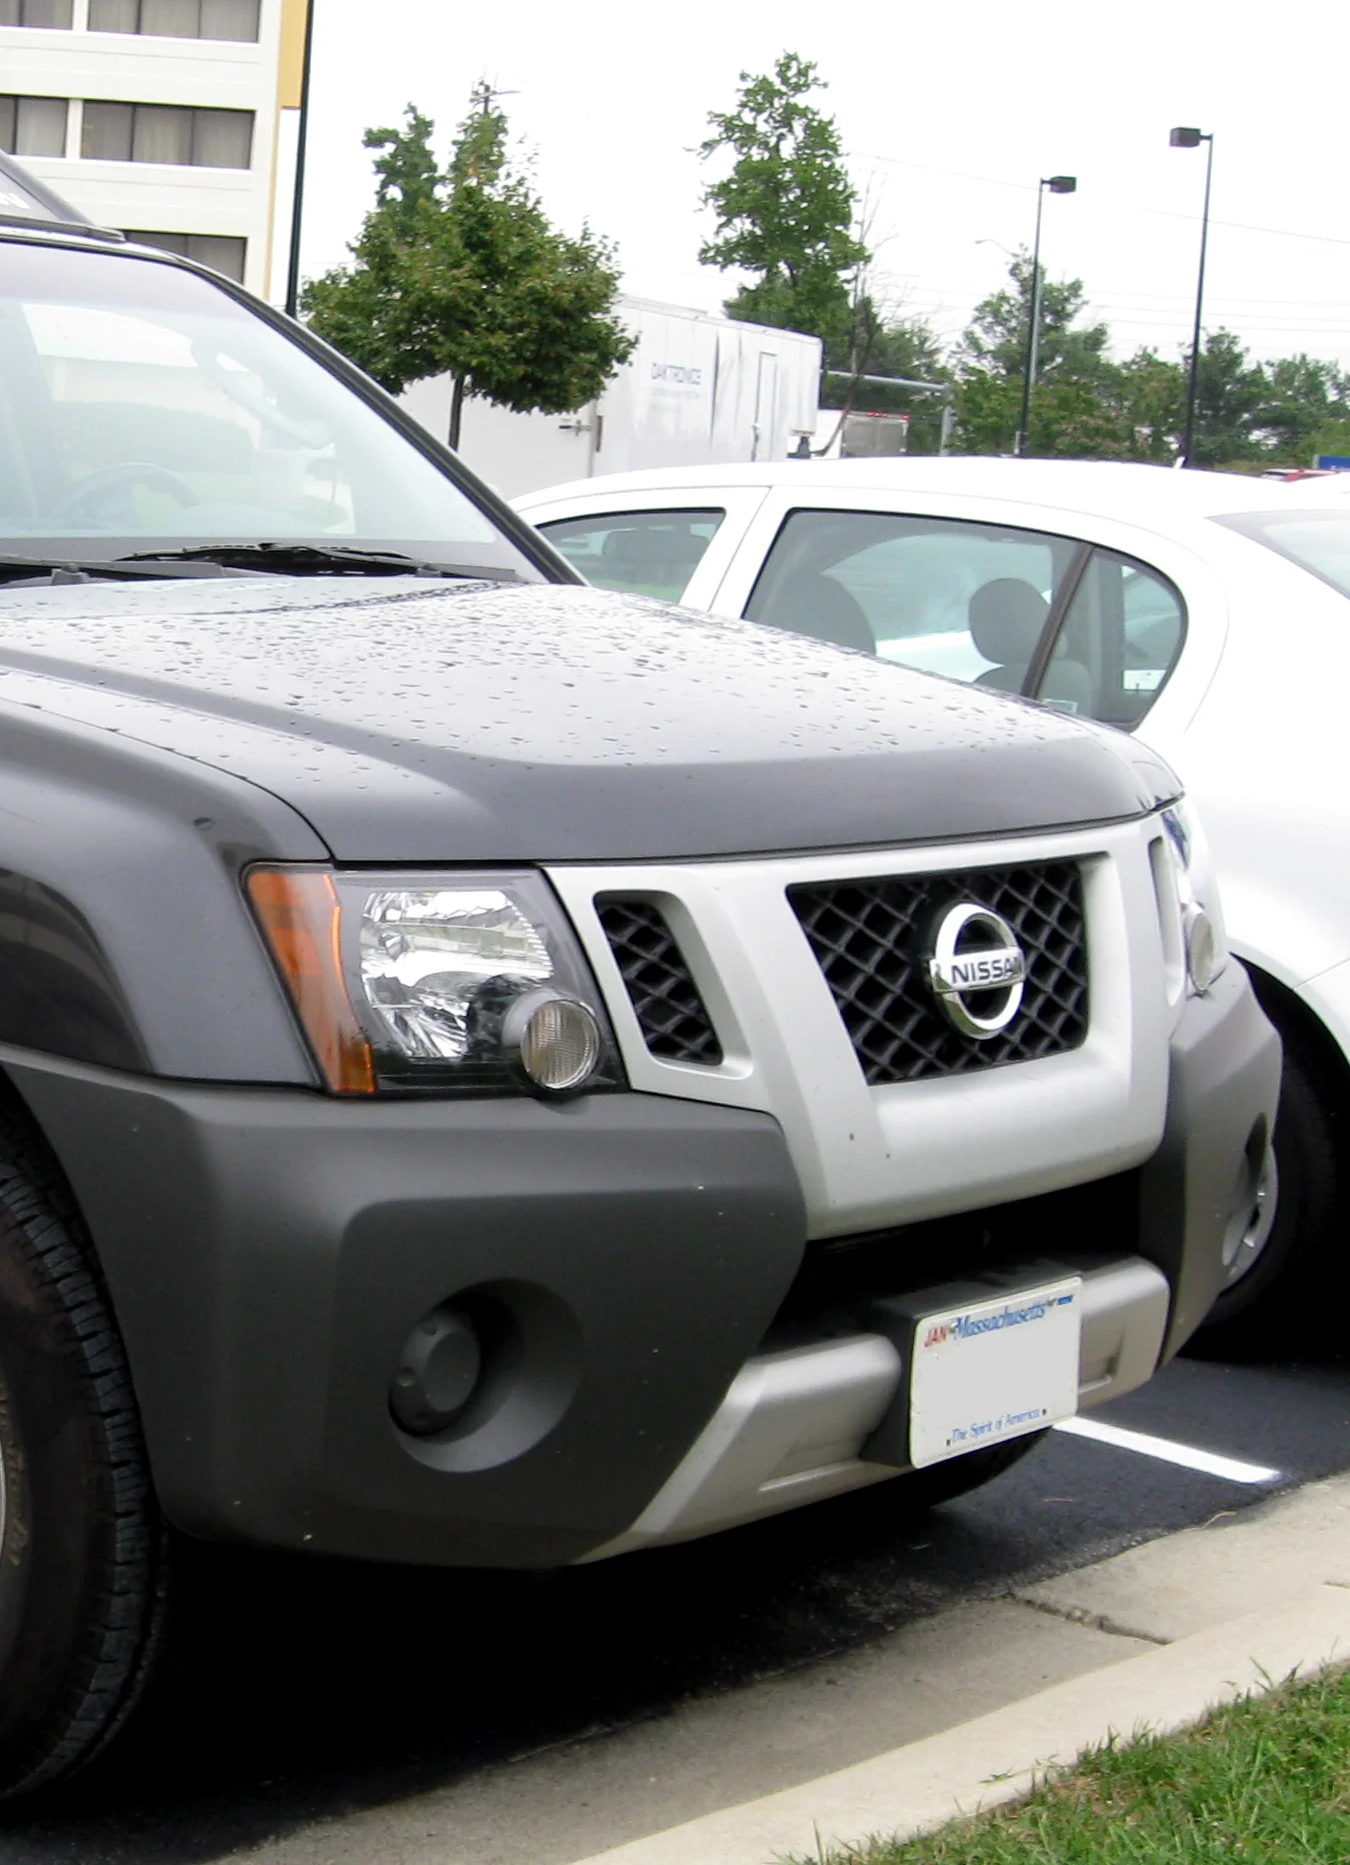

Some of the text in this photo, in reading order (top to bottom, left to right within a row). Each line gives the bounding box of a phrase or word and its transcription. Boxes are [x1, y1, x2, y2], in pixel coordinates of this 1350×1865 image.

[922, 1302, 1047, 1348] JAN Massachusetts
[952, 1407, 1041, 1443] The Spirit of America
